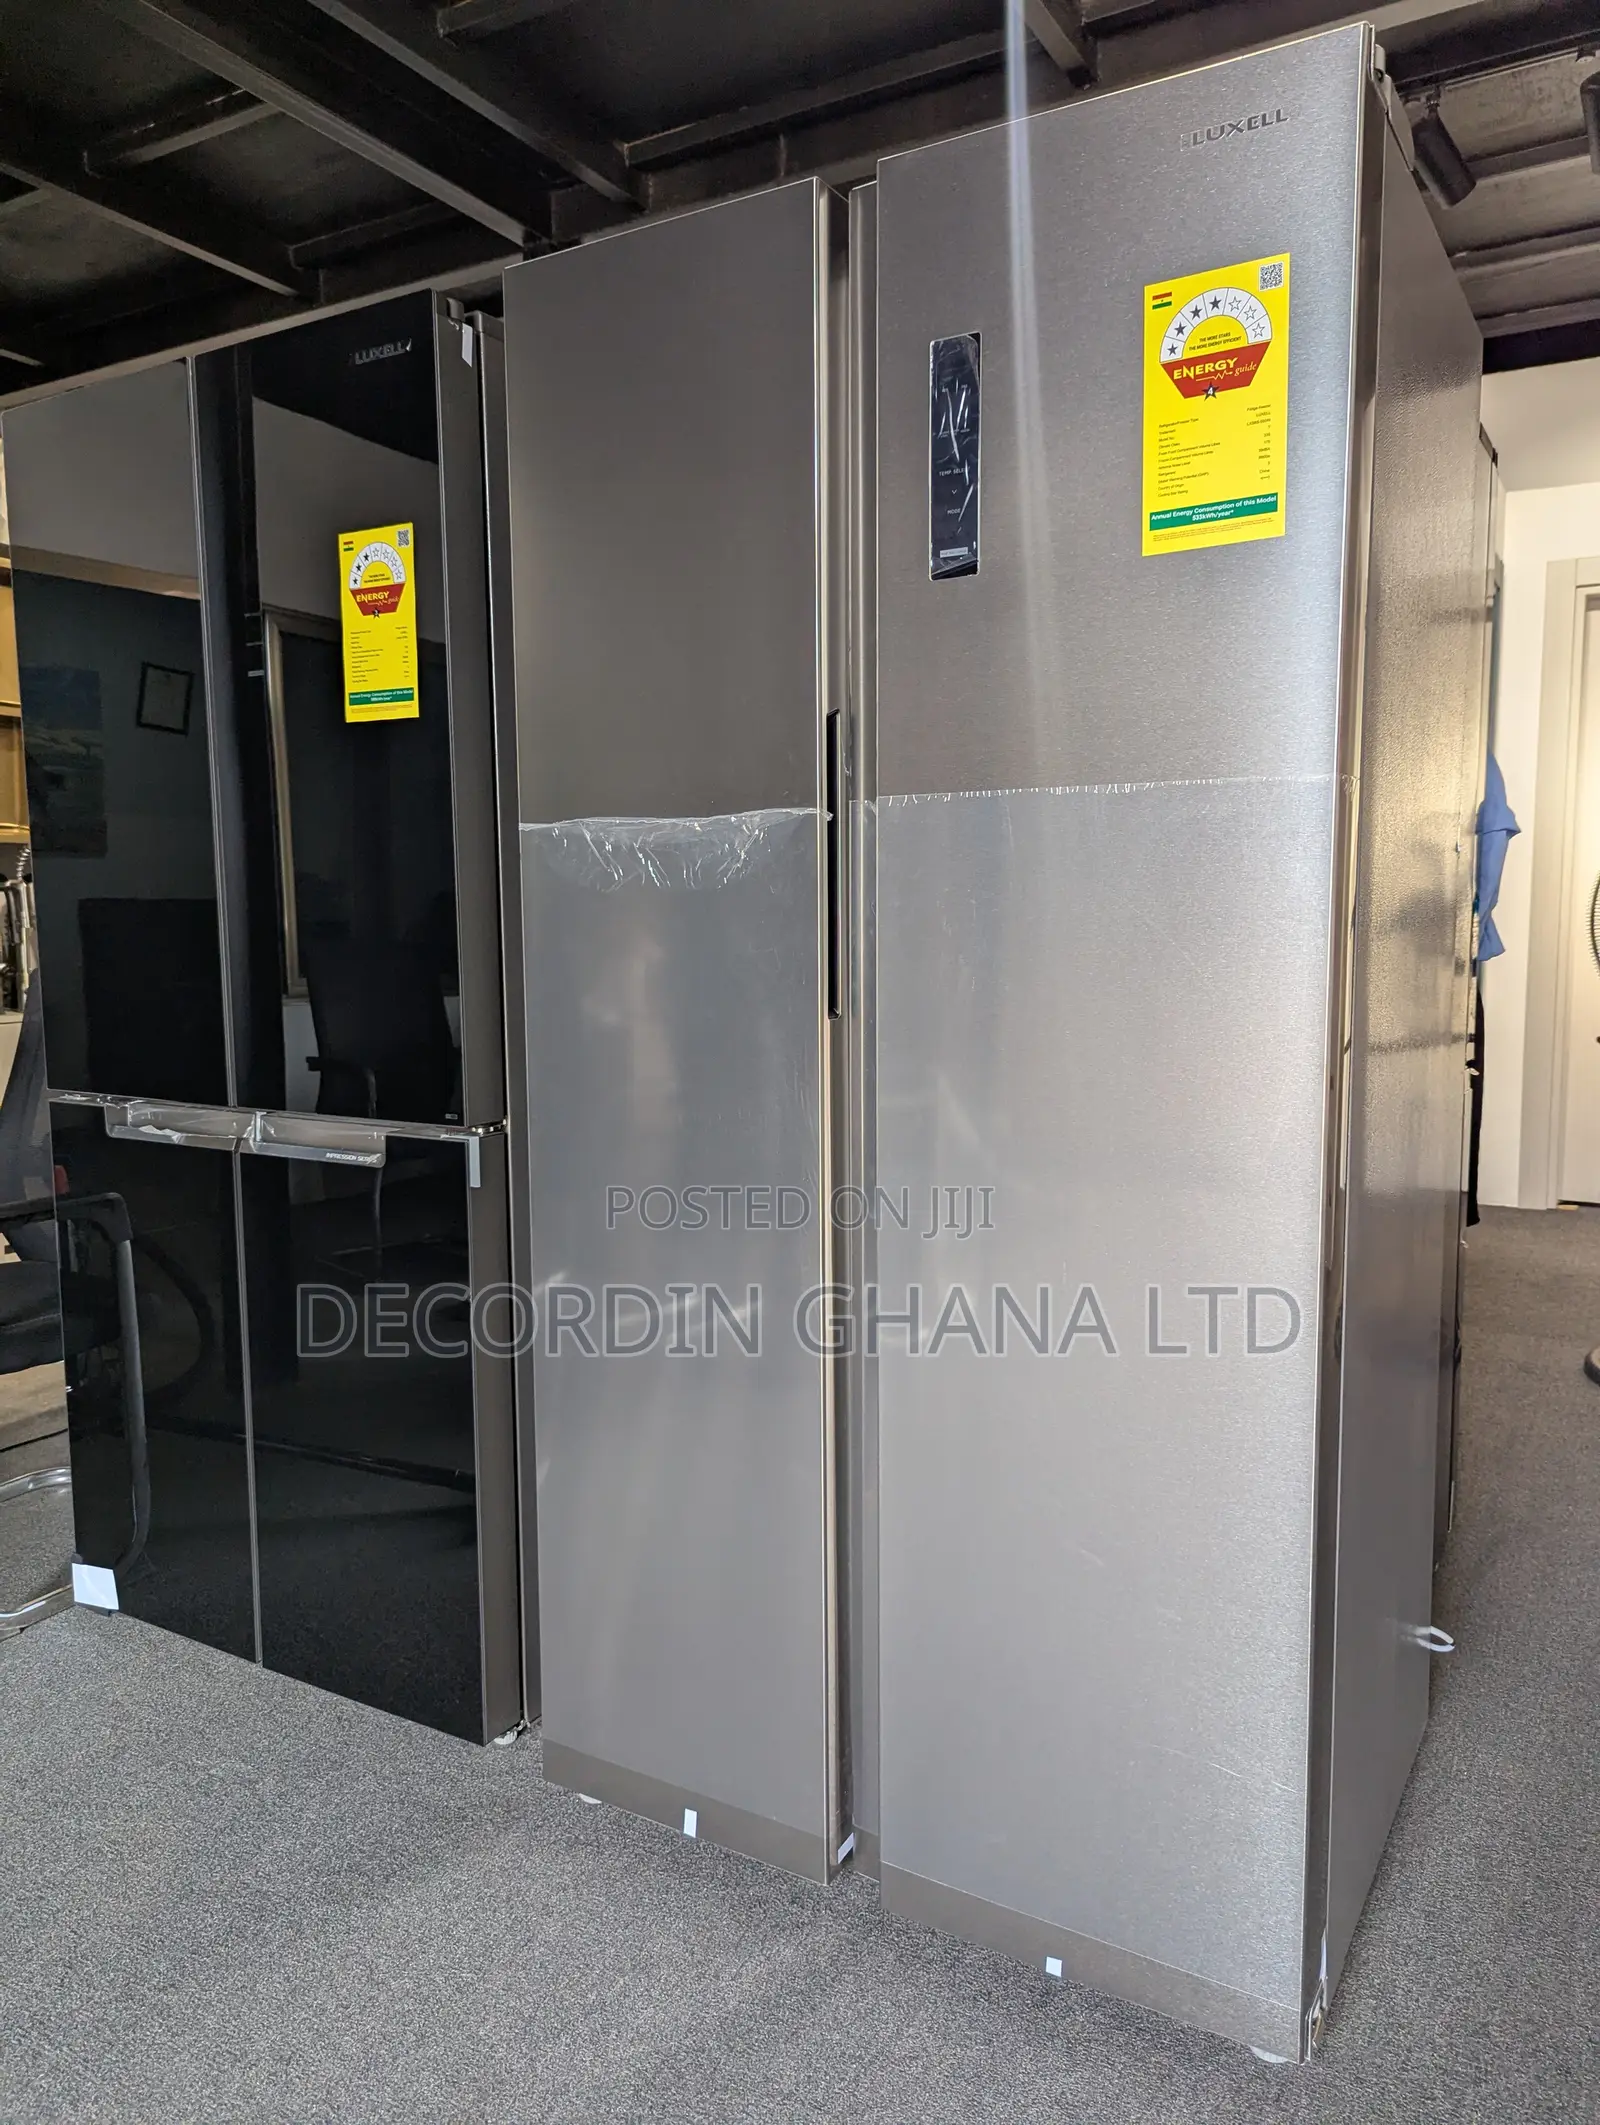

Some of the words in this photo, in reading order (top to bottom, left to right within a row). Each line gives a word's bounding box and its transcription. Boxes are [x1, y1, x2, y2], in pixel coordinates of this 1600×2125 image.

[1192, 108, 1290, 147] LUXELL
[1207, 334, 1218, 342] MORE
[355, 340, 406, 365] LUXELL
[1173, 356, 1238, 380] ENERGY
[1234, 362, 1257, 376] guide
[1207, 386, 1214, 396] 4
[1151, 512, 1172, 521] Annual
[1173, 509, 1193, 518] Energy
[1194, 503, 1235, 514] Consumption
[1256, 495, 1276, 505] Model
[356, 591, 390, 603] ENERGY
